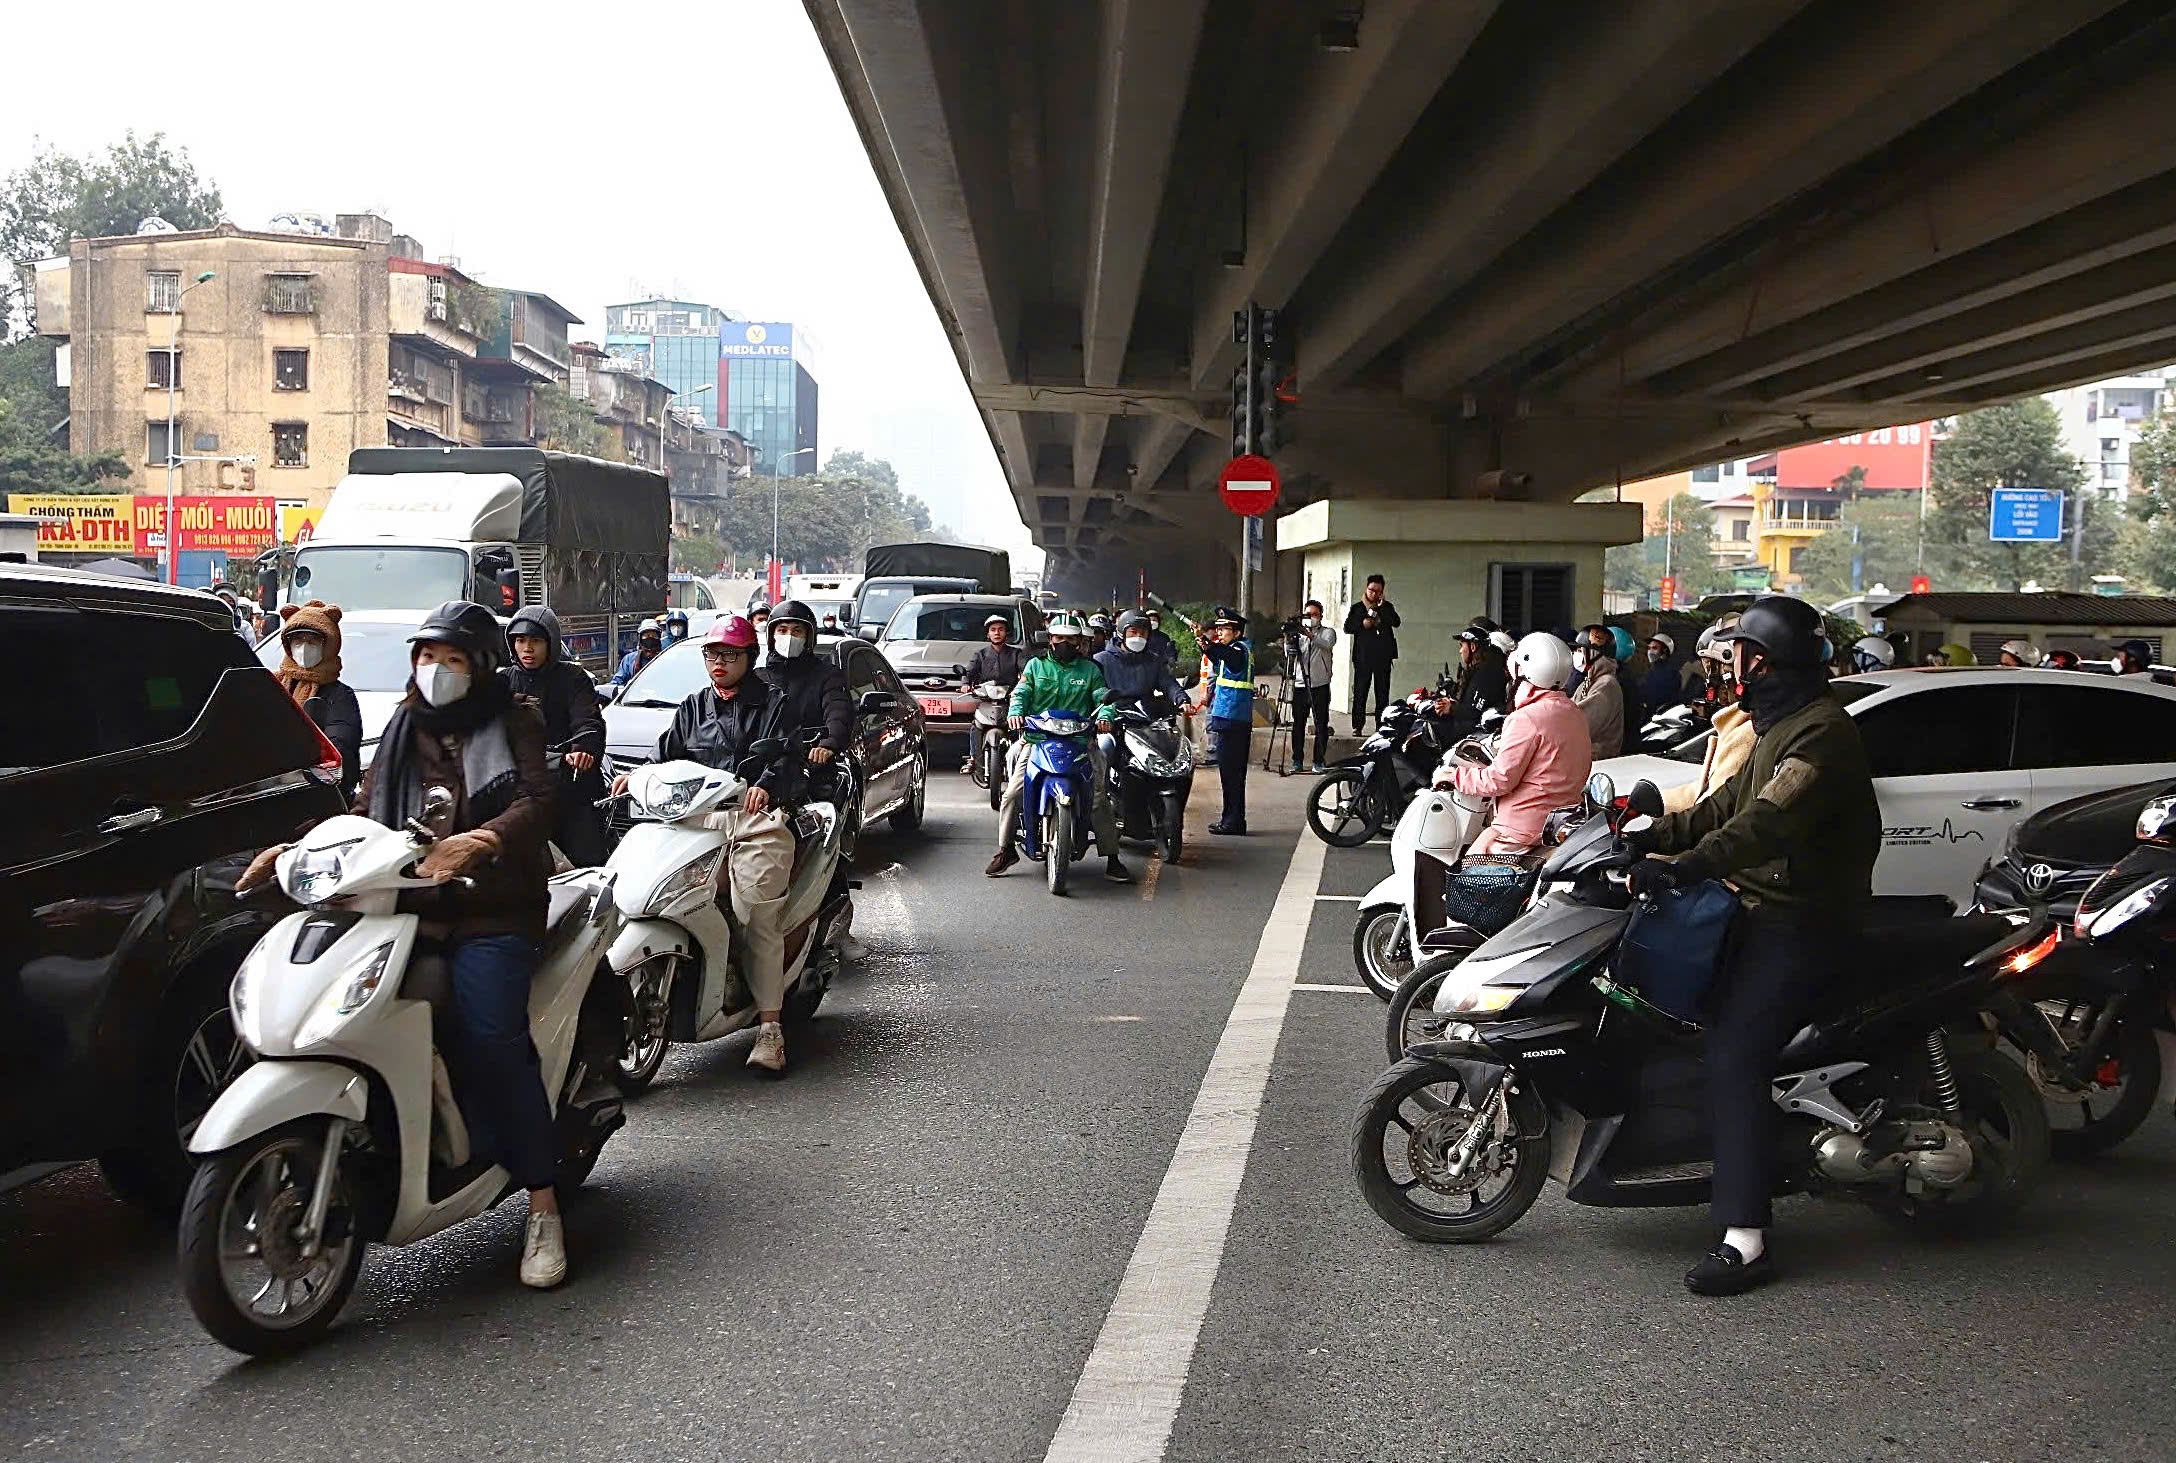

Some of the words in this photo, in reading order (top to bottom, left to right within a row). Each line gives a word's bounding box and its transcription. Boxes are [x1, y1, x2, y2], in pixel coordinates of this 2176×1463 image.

[722, 344, 790, 355] MEDLATEC
[1868, 428, 1892, 445] 20
[1897, 424, 1921, 445] 99
[217, 461, 256, 490] C3
[180, 500, 214, 530] MỐI
[225, 498, 272, 530] MUỖI
[1069, 678, 1087, 686] Grab
[926, 707, 948, 715] 71.45
[1882, 827, 1932, 836] ORT
[1522, 1048, 1567, 1059] HONDA
